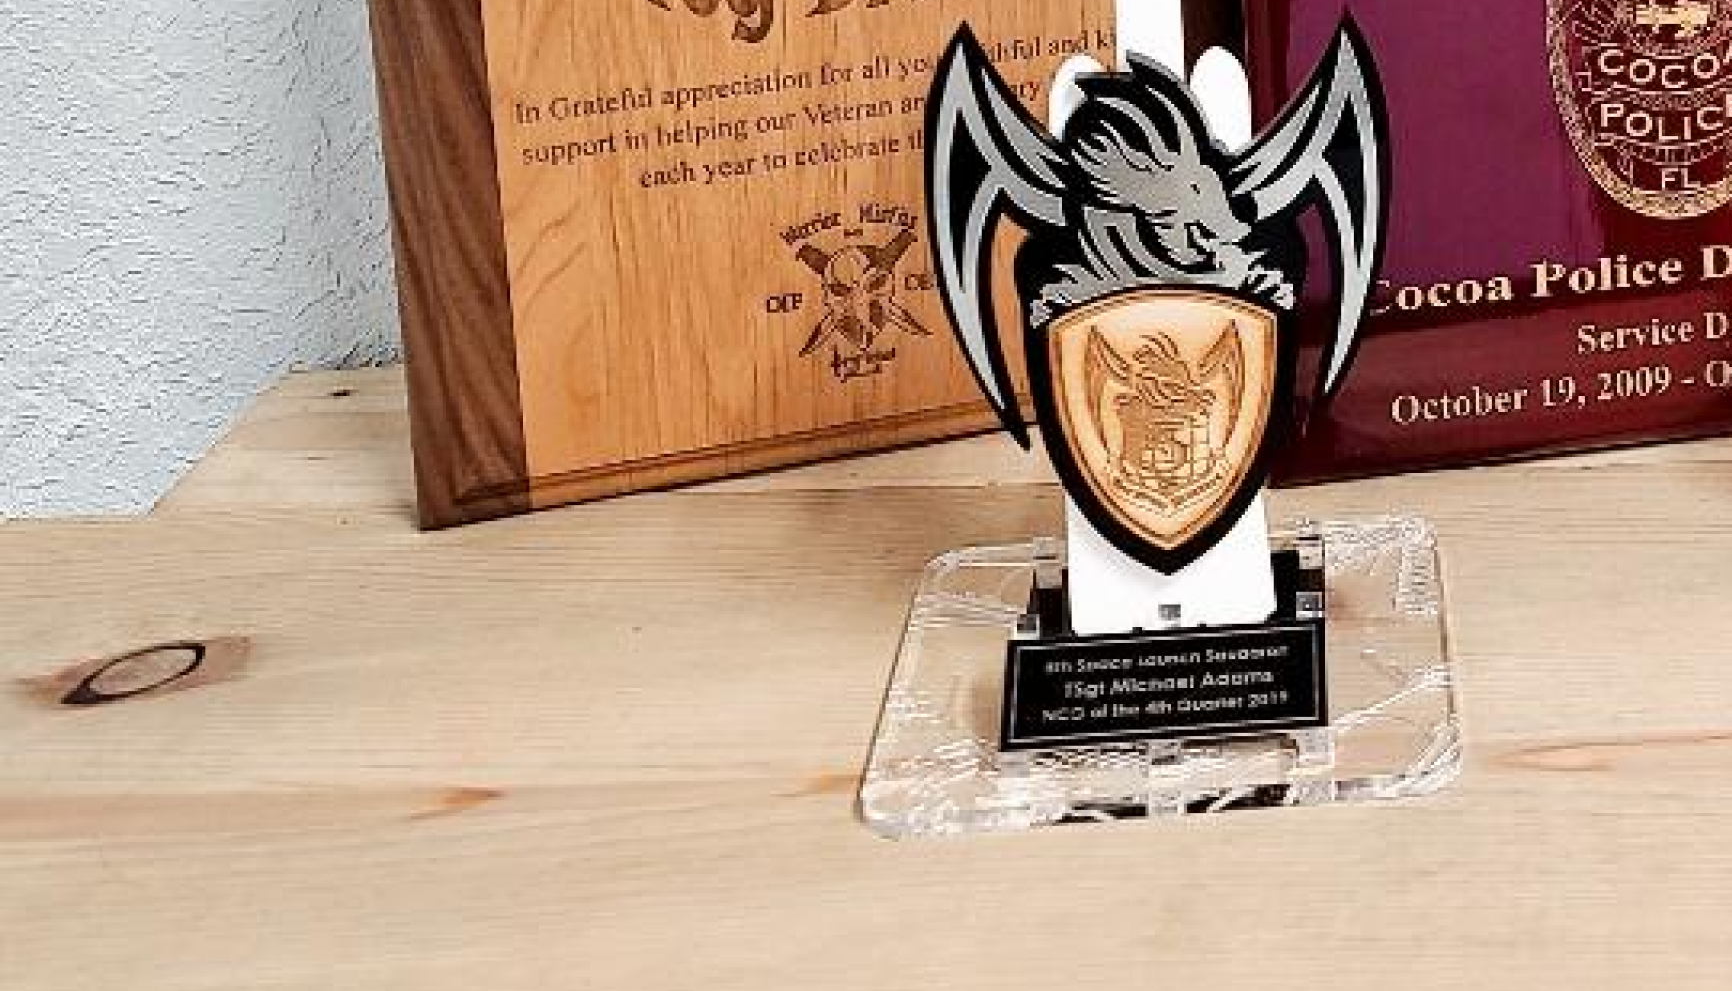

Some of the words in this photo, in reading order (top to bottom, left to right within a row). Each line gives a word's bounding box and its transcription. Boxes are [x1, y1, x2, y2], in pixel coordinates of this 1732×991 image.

[515, 102, 541, 125] In
[548, 86, 652, 120] Grateful
[660, 63, 813, 111] appreciation
[821, 61, 853, 85] for
[862, 54, 889, 80] all
[522, 131, 617, 166] support
[625, 129, 649, 150] in
[657, 119, 749, 147] helping
[756, 111, 797, 134] our
[803, 96, 893, 125] Veteran
[640, 160, 697, 188] each
[702, 157, 755, 185] year
[763, 153, 788, 172] to
[795, 133, 900, 166] celebrate
[1661, 167, 1700, 190] FL
[1530, 254, 1684, 300] Police
[1576, 318, 1696, 355] Service
[1390, 384, 1531, 426] October
[1540, 375, 1588, 409] 19,
[1597, 365, 1672, 401] 2009
[1109, 675, 1196, 695] Michael
[1201, 669, 1276, 688] Adams
[1041, 706, 1087, 722] NCO
